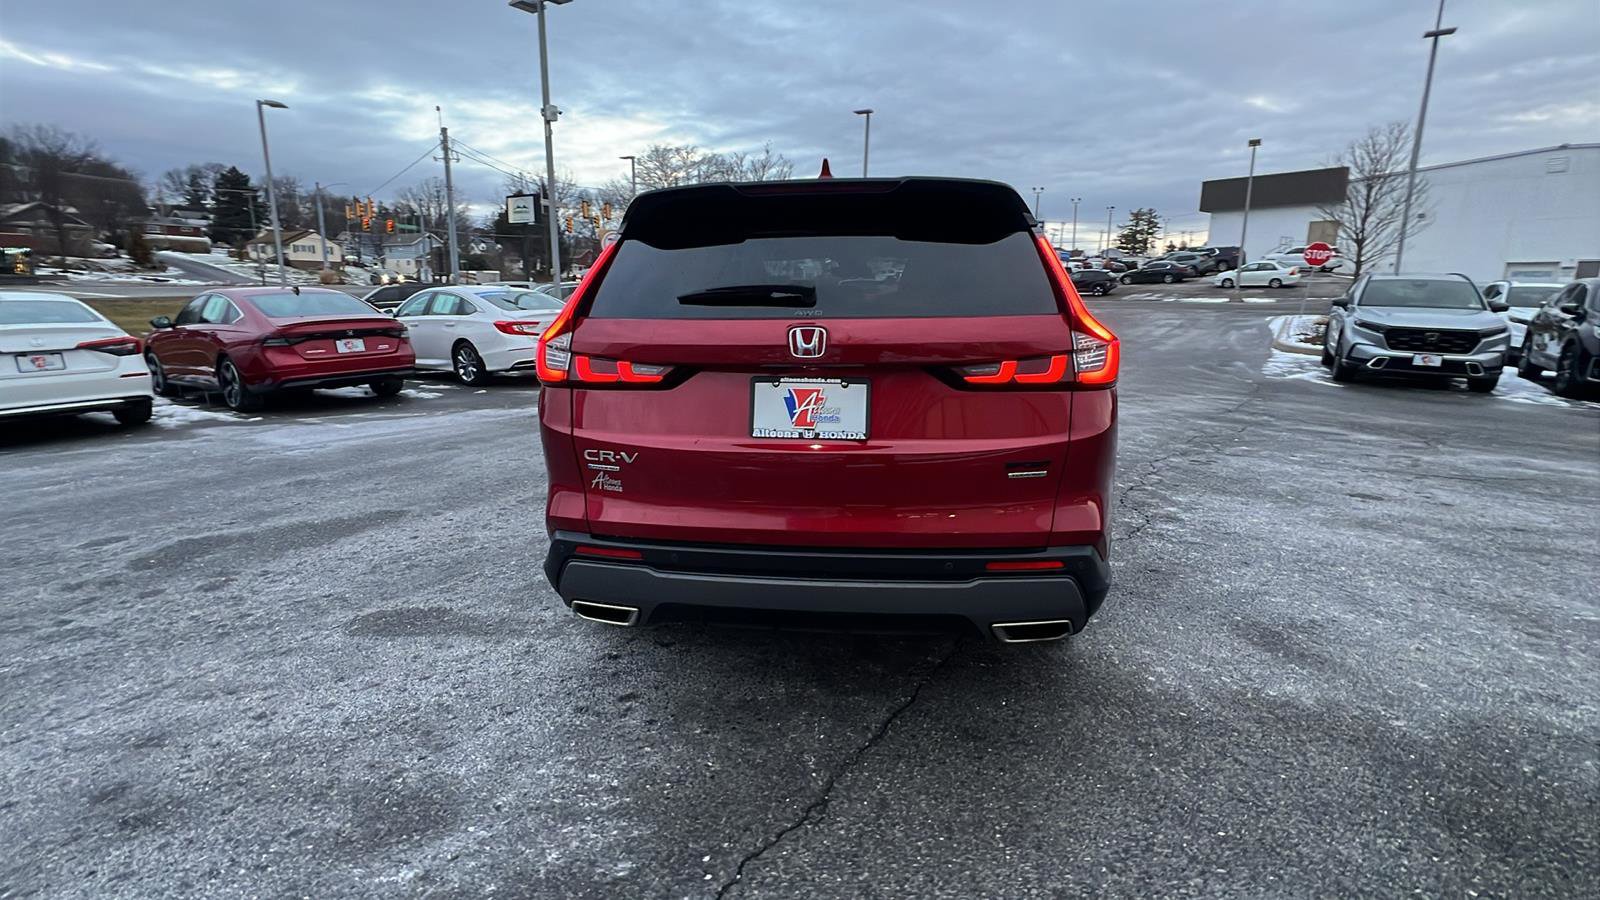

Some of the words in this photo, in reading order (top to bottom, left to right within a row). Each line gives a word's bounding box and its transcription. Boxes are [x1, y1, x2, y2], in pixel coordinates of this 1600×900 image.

[1305, 250, 1330, 259] STOP
[753, 428, 799, 438] Altoona
[818, 431, 866, 440] HONDA
[584, 450, 638, 463] CR-V
